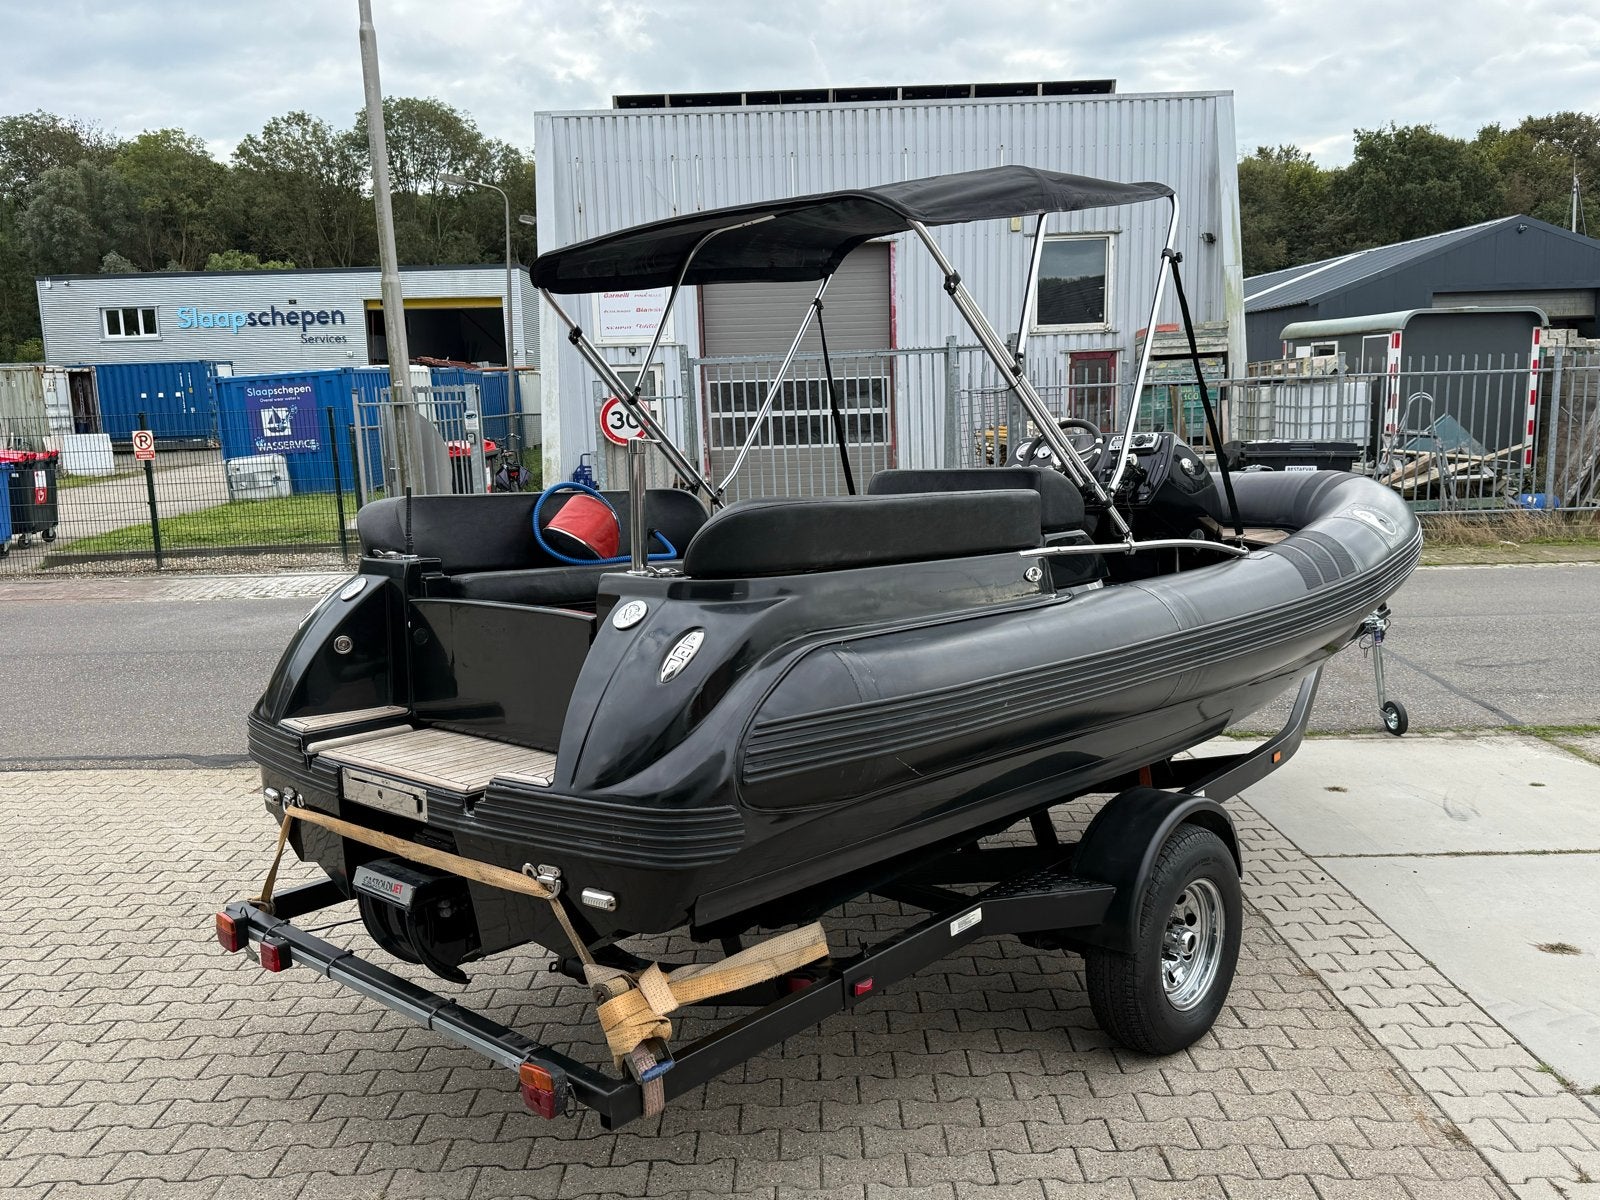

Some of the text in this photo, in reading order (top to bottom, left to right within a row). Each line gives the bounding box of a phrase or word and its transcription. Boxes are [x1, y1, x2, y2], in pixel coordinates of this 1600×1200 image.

[177, 305, 346, 335] Slaapschepen
[300, 333, 347, 344] Services
[246, 385, 312, 398] Slaapschepen
[610, 410, 640, 430] 30
[257, 439, 317, 451] WASSERVICE
